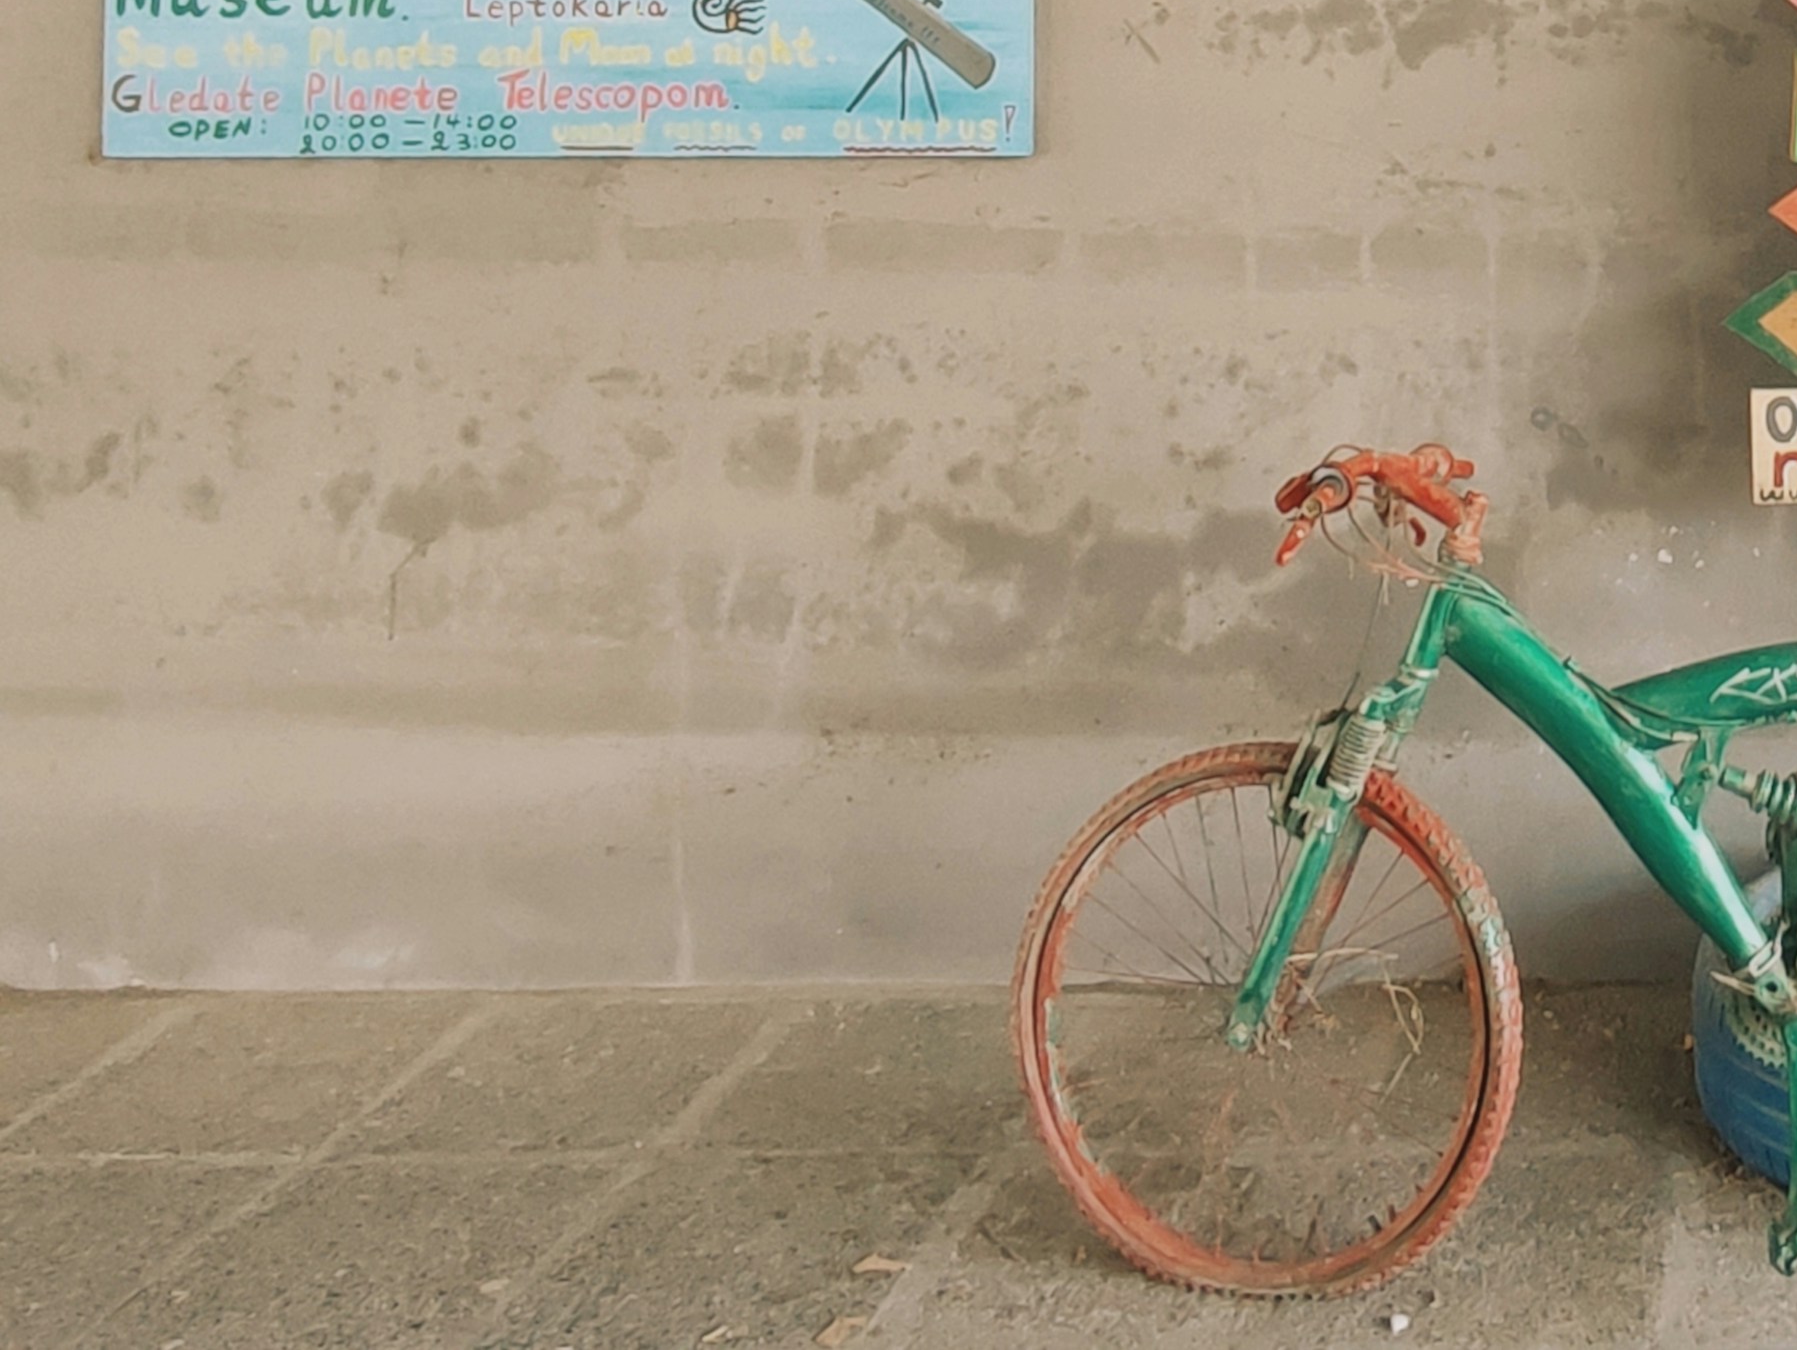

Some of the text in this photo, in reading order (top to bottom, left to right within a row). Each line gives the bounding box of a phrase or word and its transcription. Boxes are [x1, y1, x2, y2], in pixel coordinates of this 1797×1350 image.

[309, 26, 458, 69] Planets
[478, 27, 545, 69] and
[111, 74, 281, 113] Gledate
[306, 72, 459, 113] Planete
